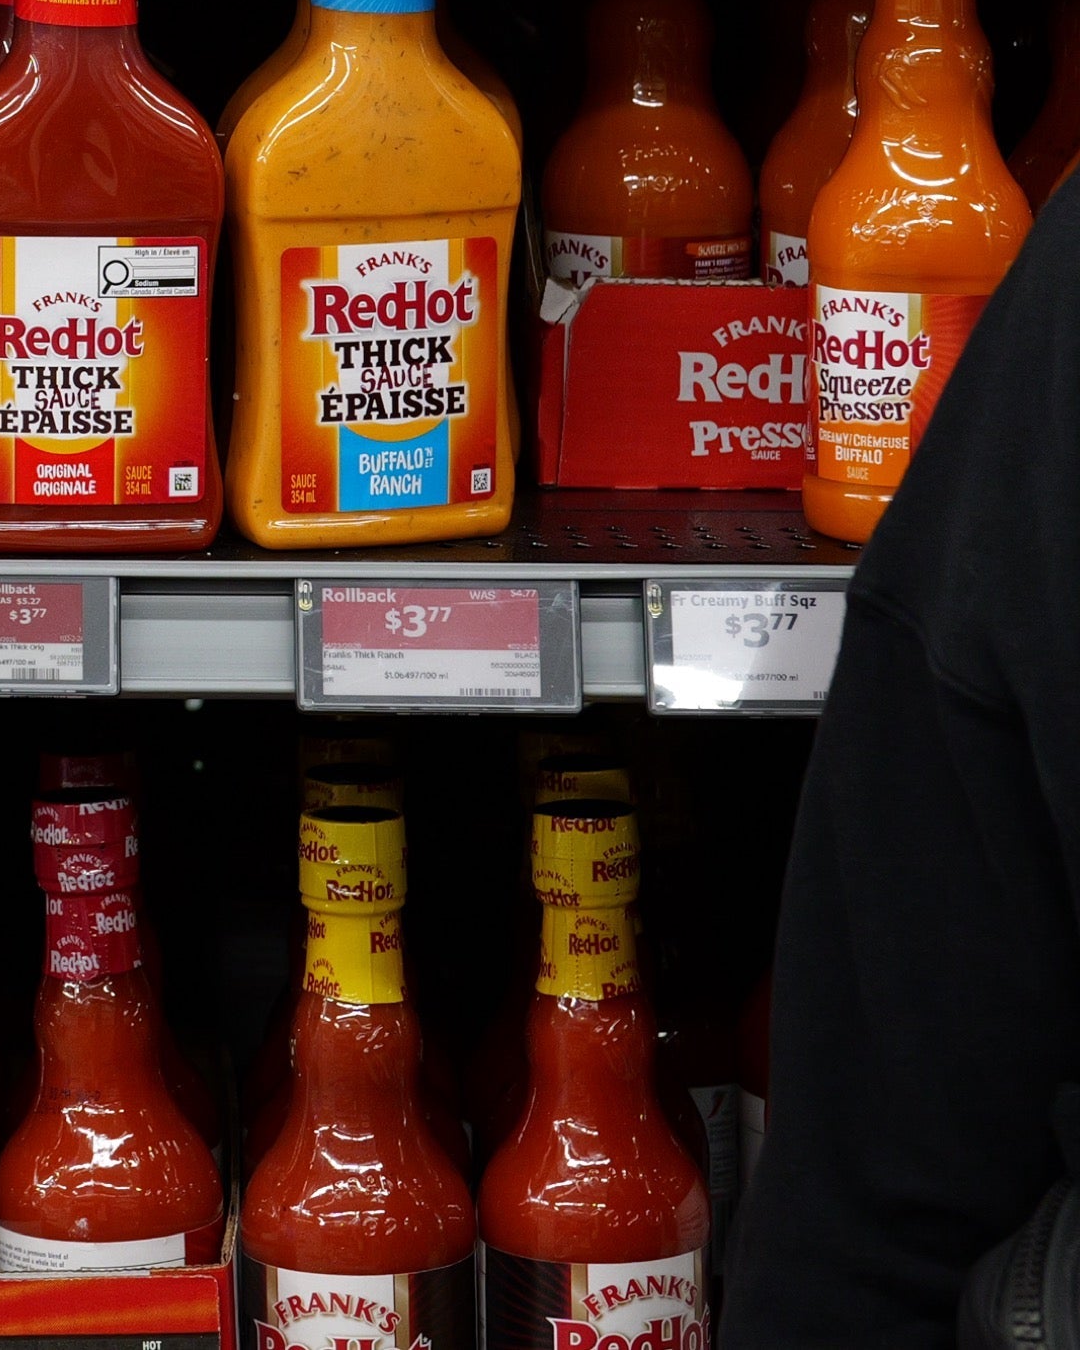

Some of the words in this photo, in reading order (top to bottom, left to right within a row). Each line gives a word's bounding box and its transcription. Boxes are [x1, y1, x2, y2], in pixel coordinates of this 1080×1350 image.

[355, 251, 433, 277] FRANK'S
[32, 291, 103, 313] FRANK'S
[311, 279, 474, 335] RedHot
[335, 335, 453, 369] THICK
[813, 329, 930, 371] RedHot
[12, 366, 121, 390] THICK
[819, 369, 911, 398] Squeeze
[320, 385, 465, 423] ÉPAISSE
[819, 396, 911, 422] Presser
[0, 403, 133, 433] ÉPAISSE
[359, 448, 424, 474] BUFFALO
[835, 446, 882, 465] BUFFALO
[126, 466, 152, 480] SAUCE
[370, 476, 421, 496] RANCH
[125, 481, 139, 494] 354
[322, 589, 396, 603] Rollback
[469, 590, 496, 600] WAS
[672, 595, 685, 606] Fr
[691, 594, 748, 609] Creamy
[755, 594, 786, 607] Buff
[790, 595, 817, 609] Sqz
[582, 1274, 697, 1318] FRANK'S
[272, 1291, 401, 1333] FRANK'S
[142, 1341, 162, 1350] HOT
